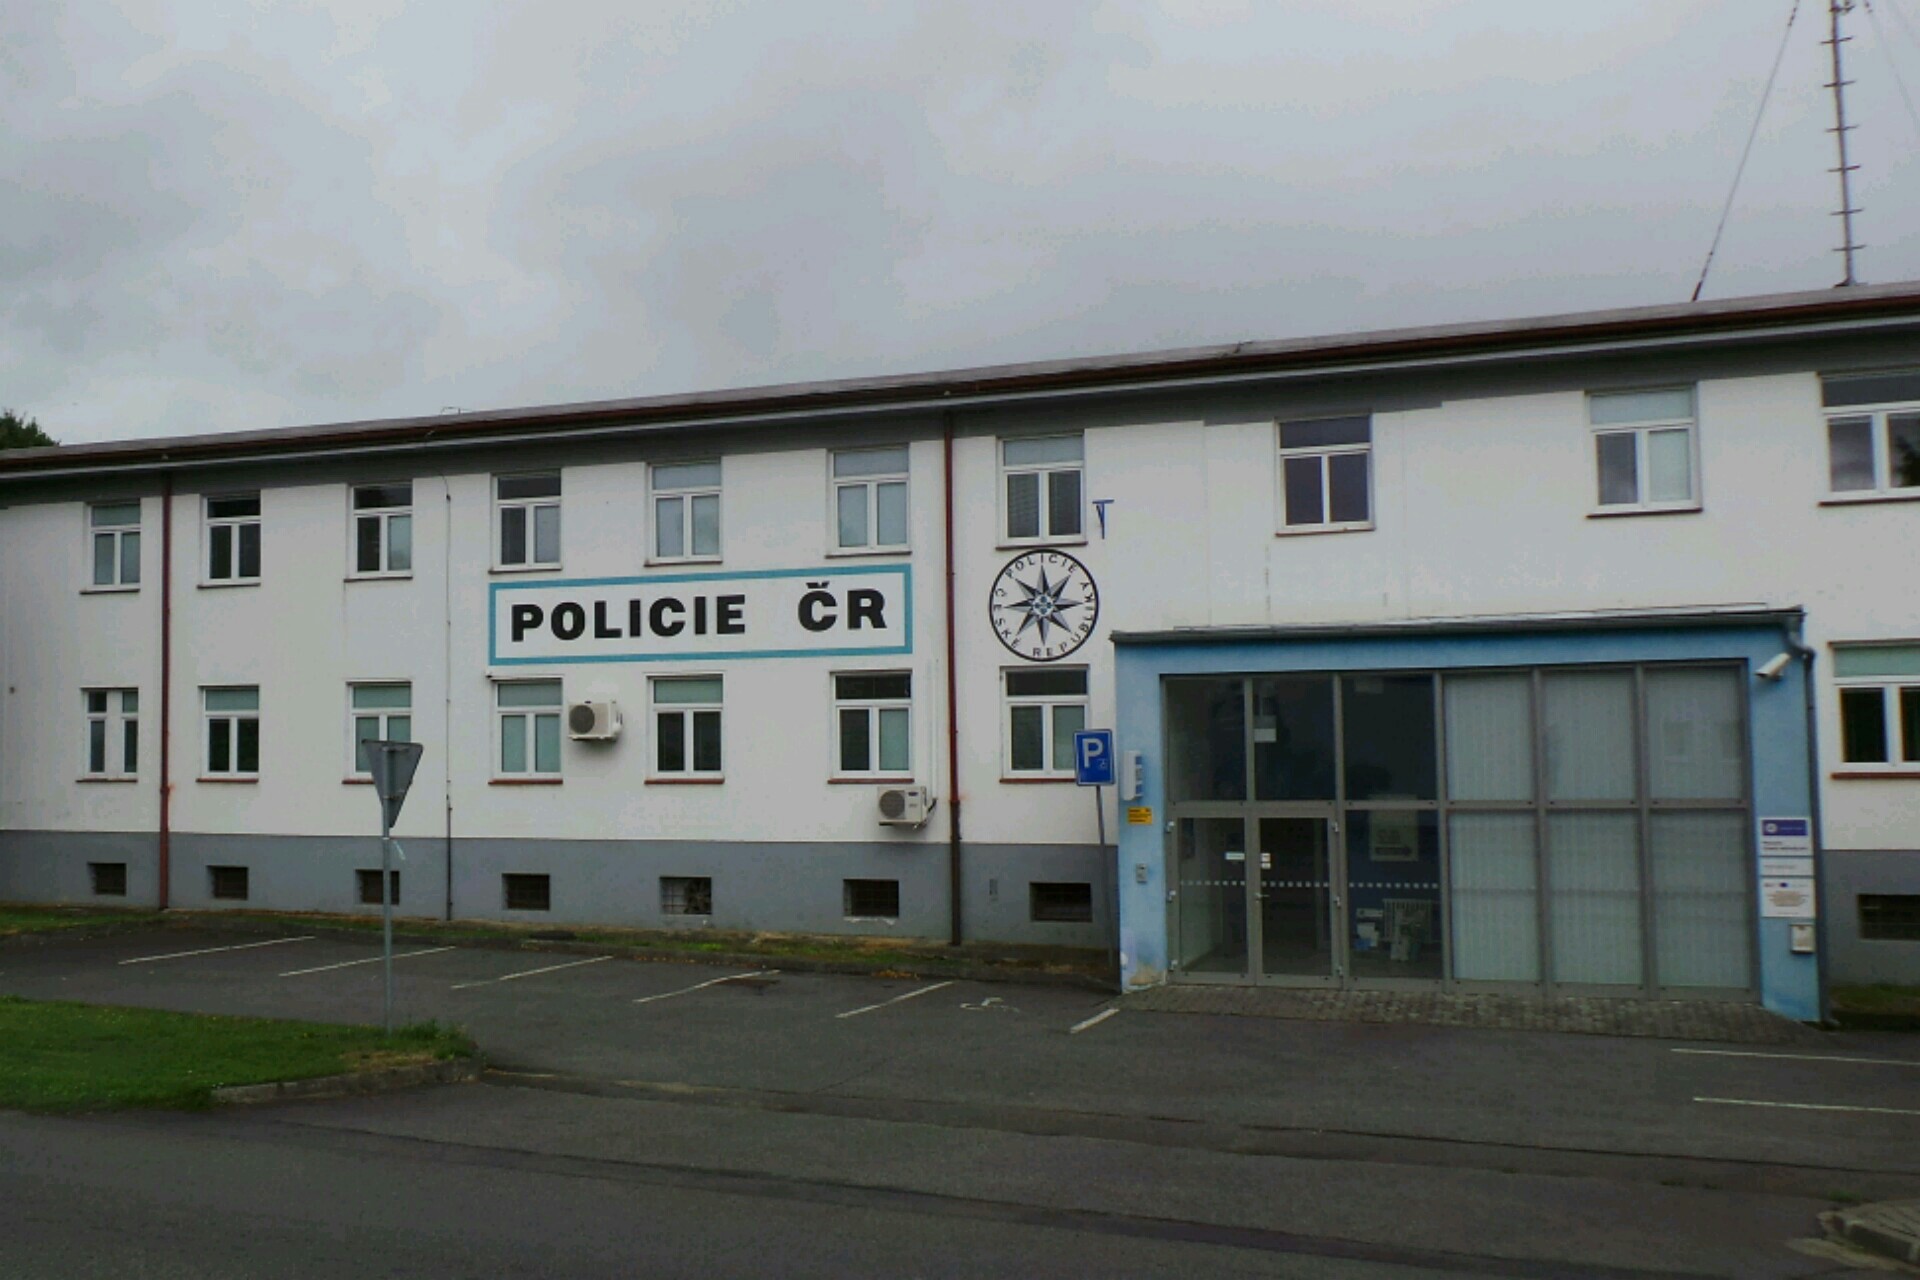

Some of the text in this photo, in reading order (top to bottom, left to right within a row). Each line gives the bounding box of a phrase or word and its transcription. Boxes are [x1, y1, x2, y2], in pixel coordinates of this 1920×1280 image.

[1004, 553, 1077, 580] POLICIE
[511, 581, 887, 642] POLICIE ČR
[1032, 581, 1094, 657] REPUBLIKY
[1082, 738, 1103, 768] P
